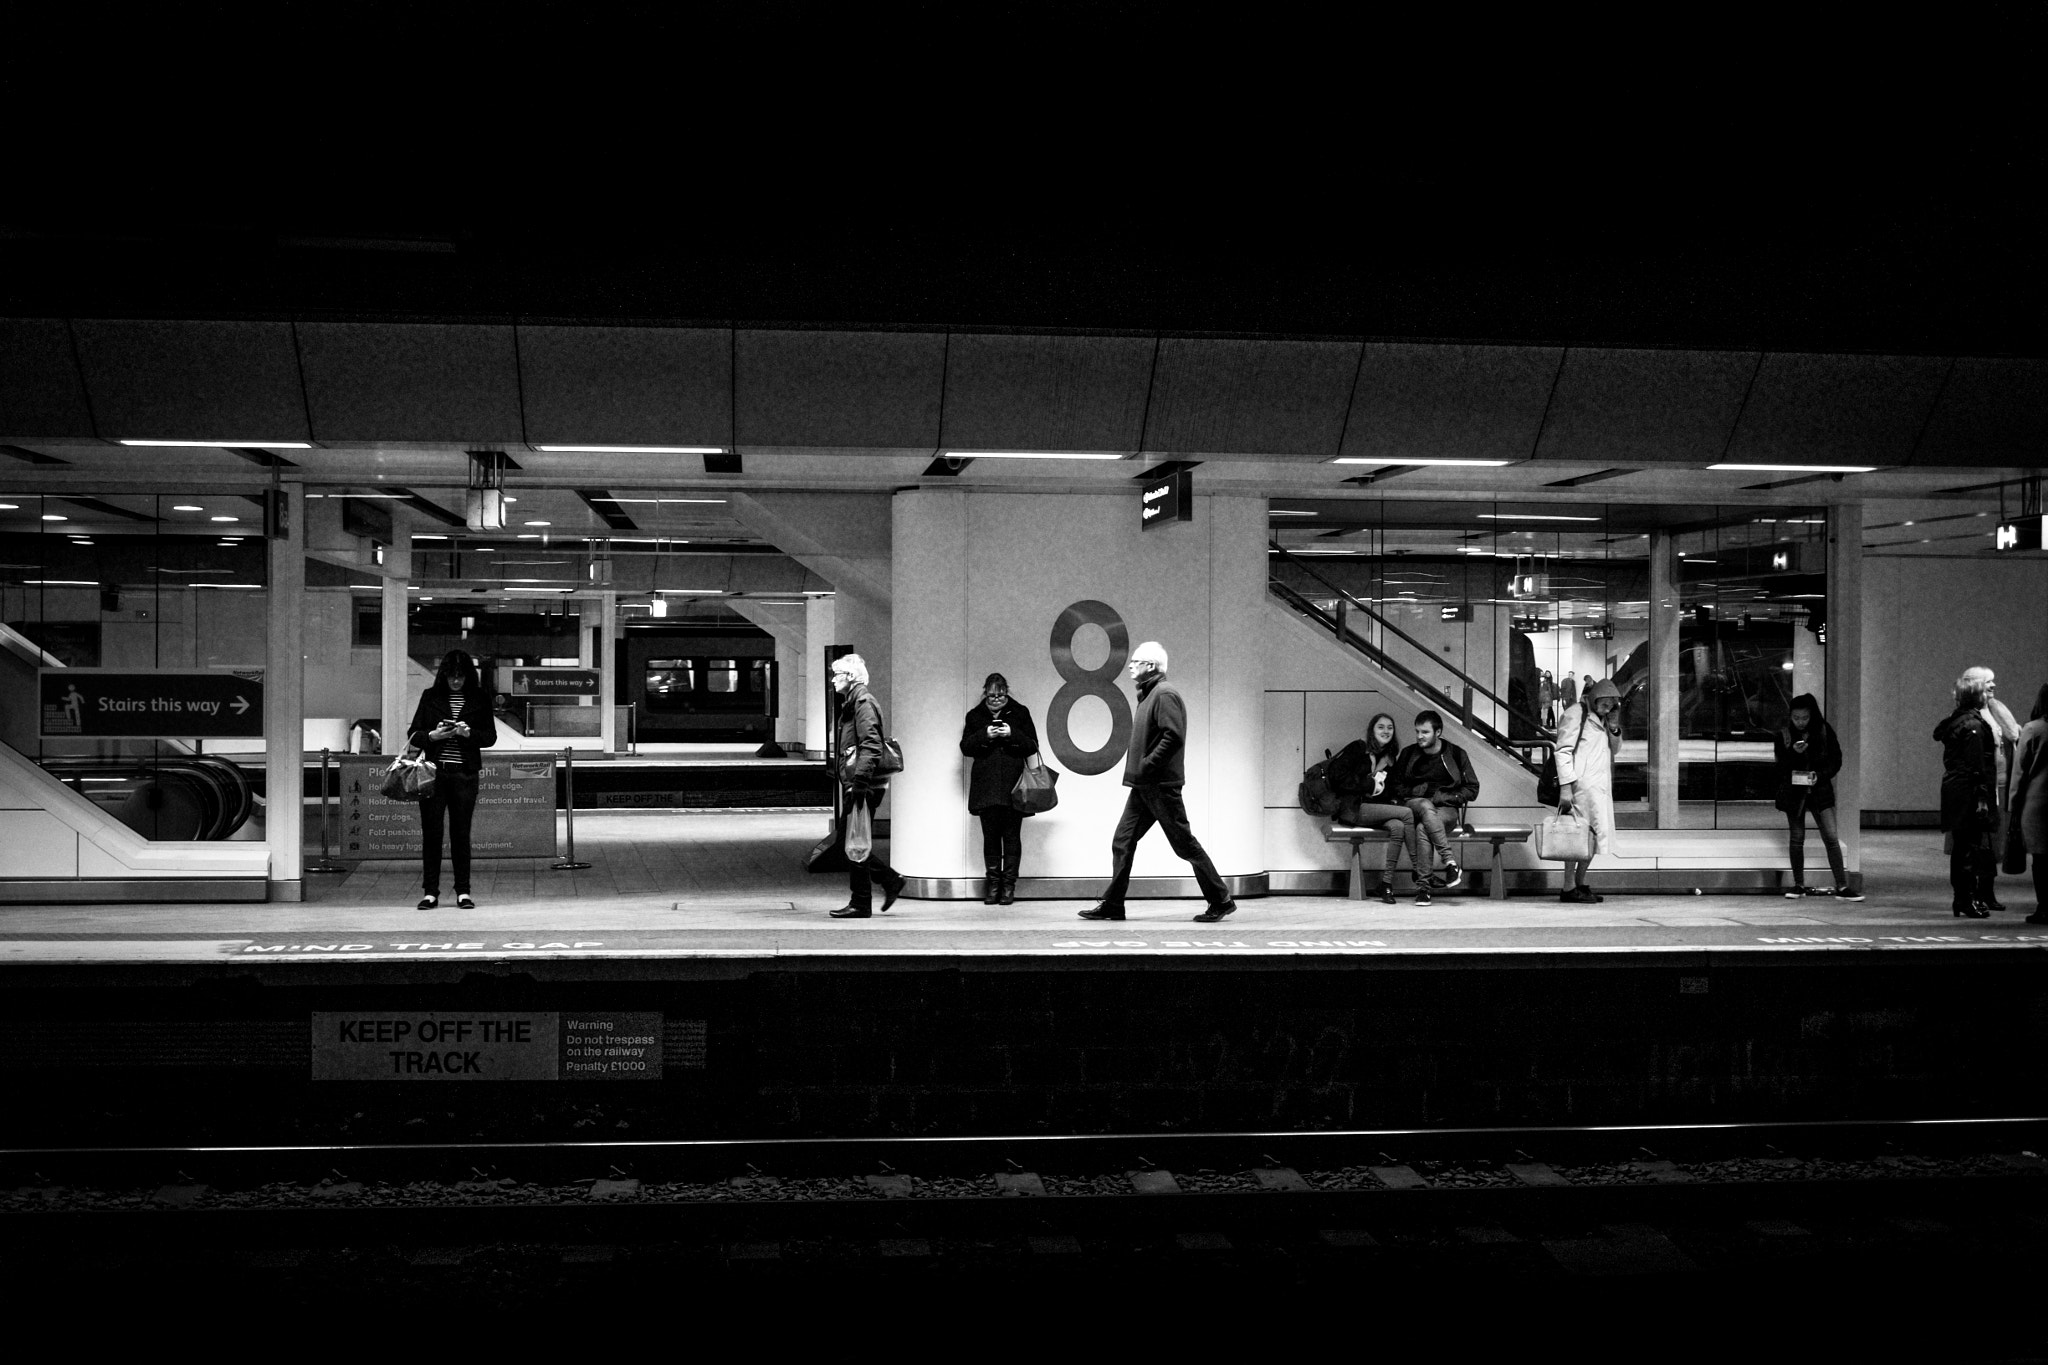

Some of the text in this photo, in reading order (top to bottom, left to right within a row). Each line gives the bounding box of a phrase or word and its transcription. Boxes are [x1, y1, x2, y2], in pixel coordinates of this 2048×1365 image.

[534, 678, 583, 688] Stairs this way
[1047, 600, 1133, 776] 8
[98, 697, 221, 716] Stairs this way
[368, 767, 499, 779] Ple ght.
[368, 783, 382, 791] Hol
[502, 782, 523, 791] edge.
[368, 798, 387, 806] Hold
[478, 797, 512, 805] direction
[513, 796, 522, 804] of
[523, 796, 548, 804] travel.
[606, 794, 632, 804] KEEP
[633, 794, 653, 803] OFF
[654, 793, 673, 803] THE
[368, 813, 414, 823] Carry dogs.
[368, 828, 424, 838] Fold pushchai
[368, 843, 380, 851] No
[381, 842, 405, 852] heavy
[406, 842, 424, 852] lugg
[243, 944, 374, 953] MIND
[502, 942, 604, 950] GAP
[1052, 940, 1148, 948] GAP
[1266, 940, 1388, 948] MIND
[340, 1020, 531, 1043] KEEP OFF THE
[567, 1020, 614, 1032] Warning
[566, 1035, 655, 1047] Do not trespass
[566, 1046, 645, 1058] on the railway
[389, 1051, 482, 1074] TRACK
[566, 1061, 646, 1073] Penalty £1000
